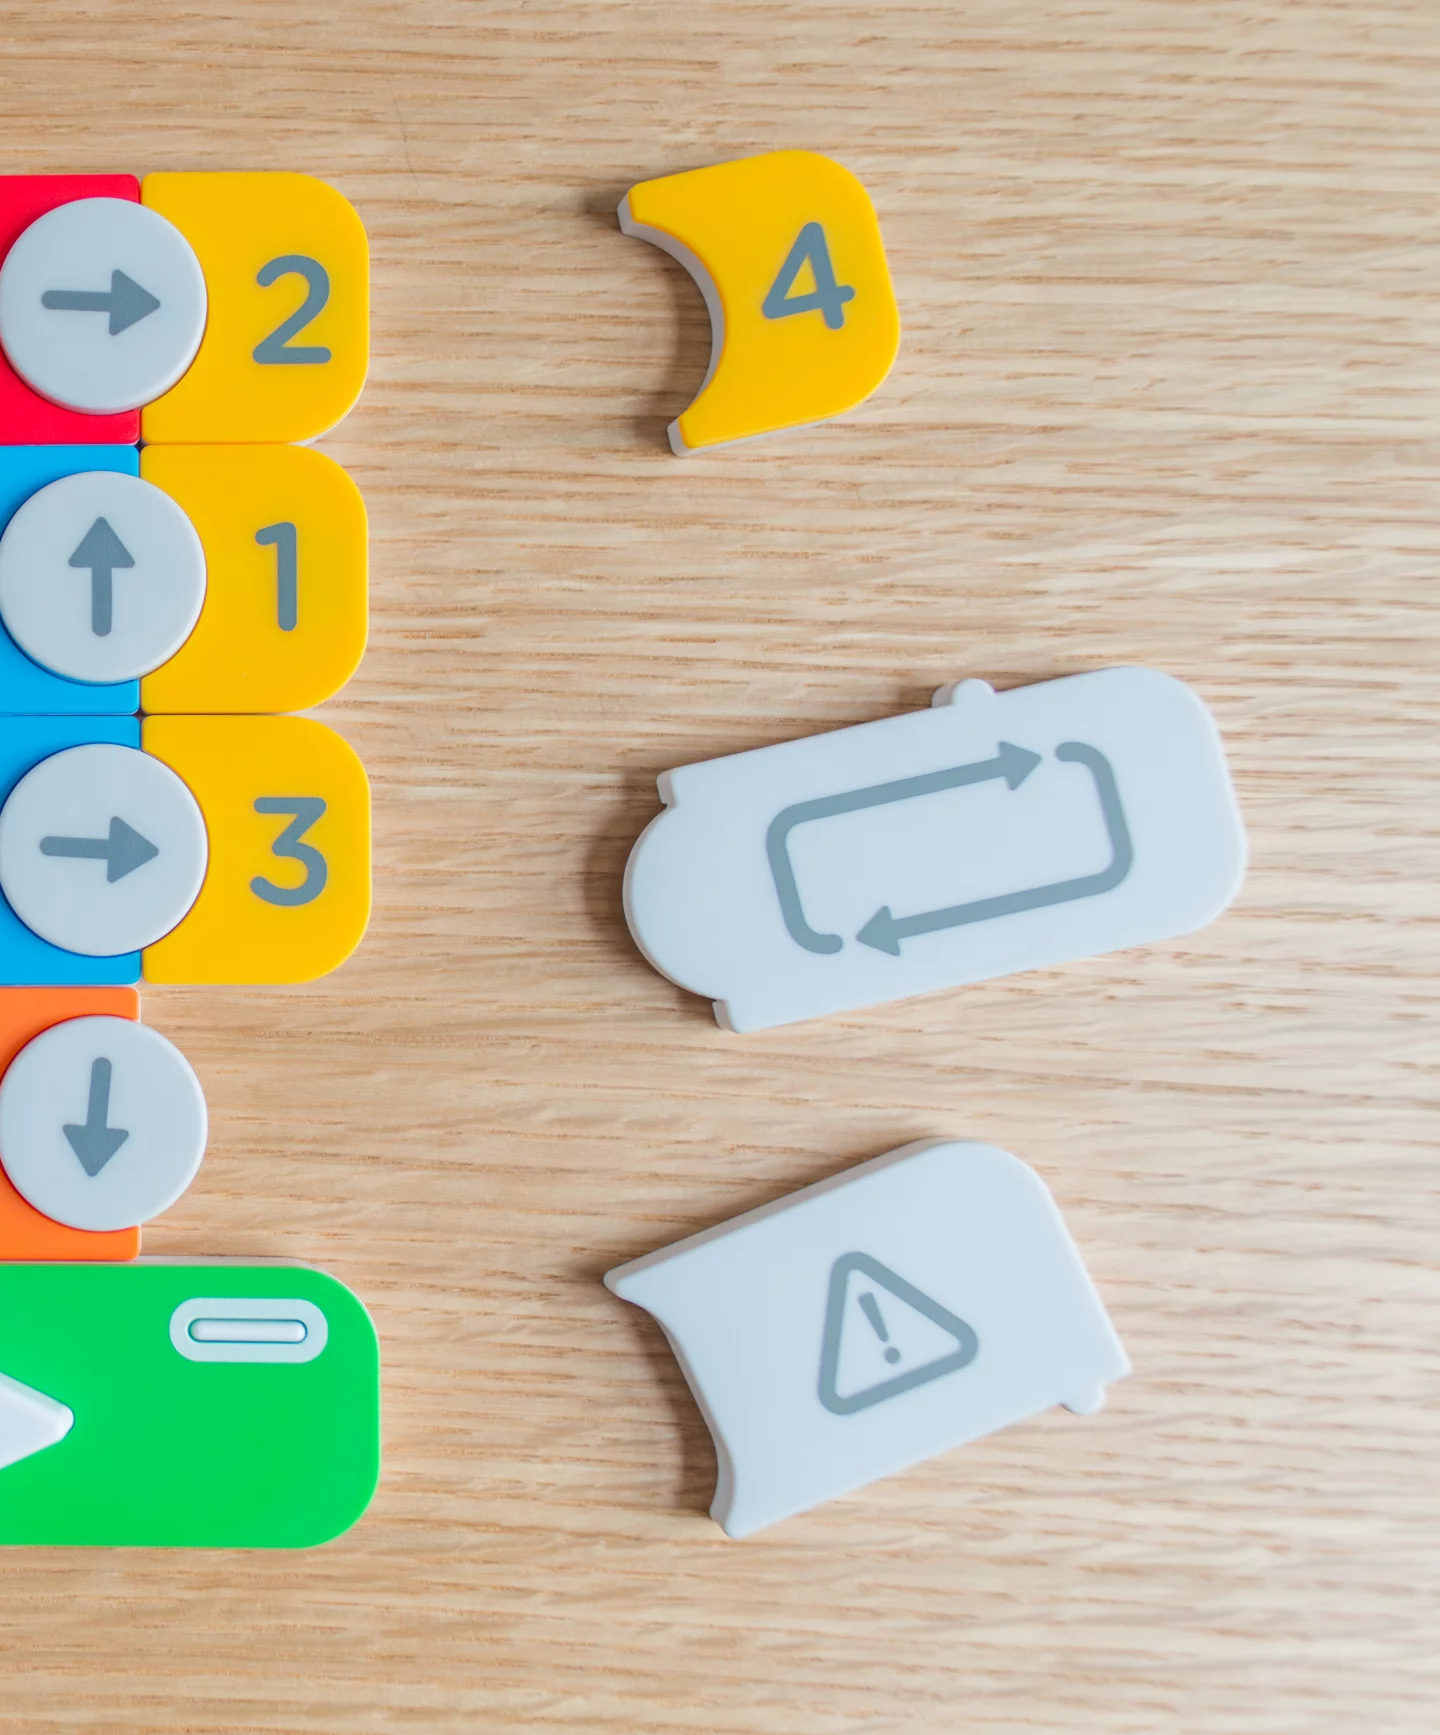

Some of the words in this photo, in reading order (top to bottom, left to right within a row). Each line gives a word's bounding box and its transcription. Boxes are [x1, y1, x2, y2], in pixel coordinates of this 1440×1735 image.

[253, 254, 332, 365] 2
[762, 222, 856, 330] 4
[255, 522, 298, 632] 1
[250, 796, 328, 907] 3
